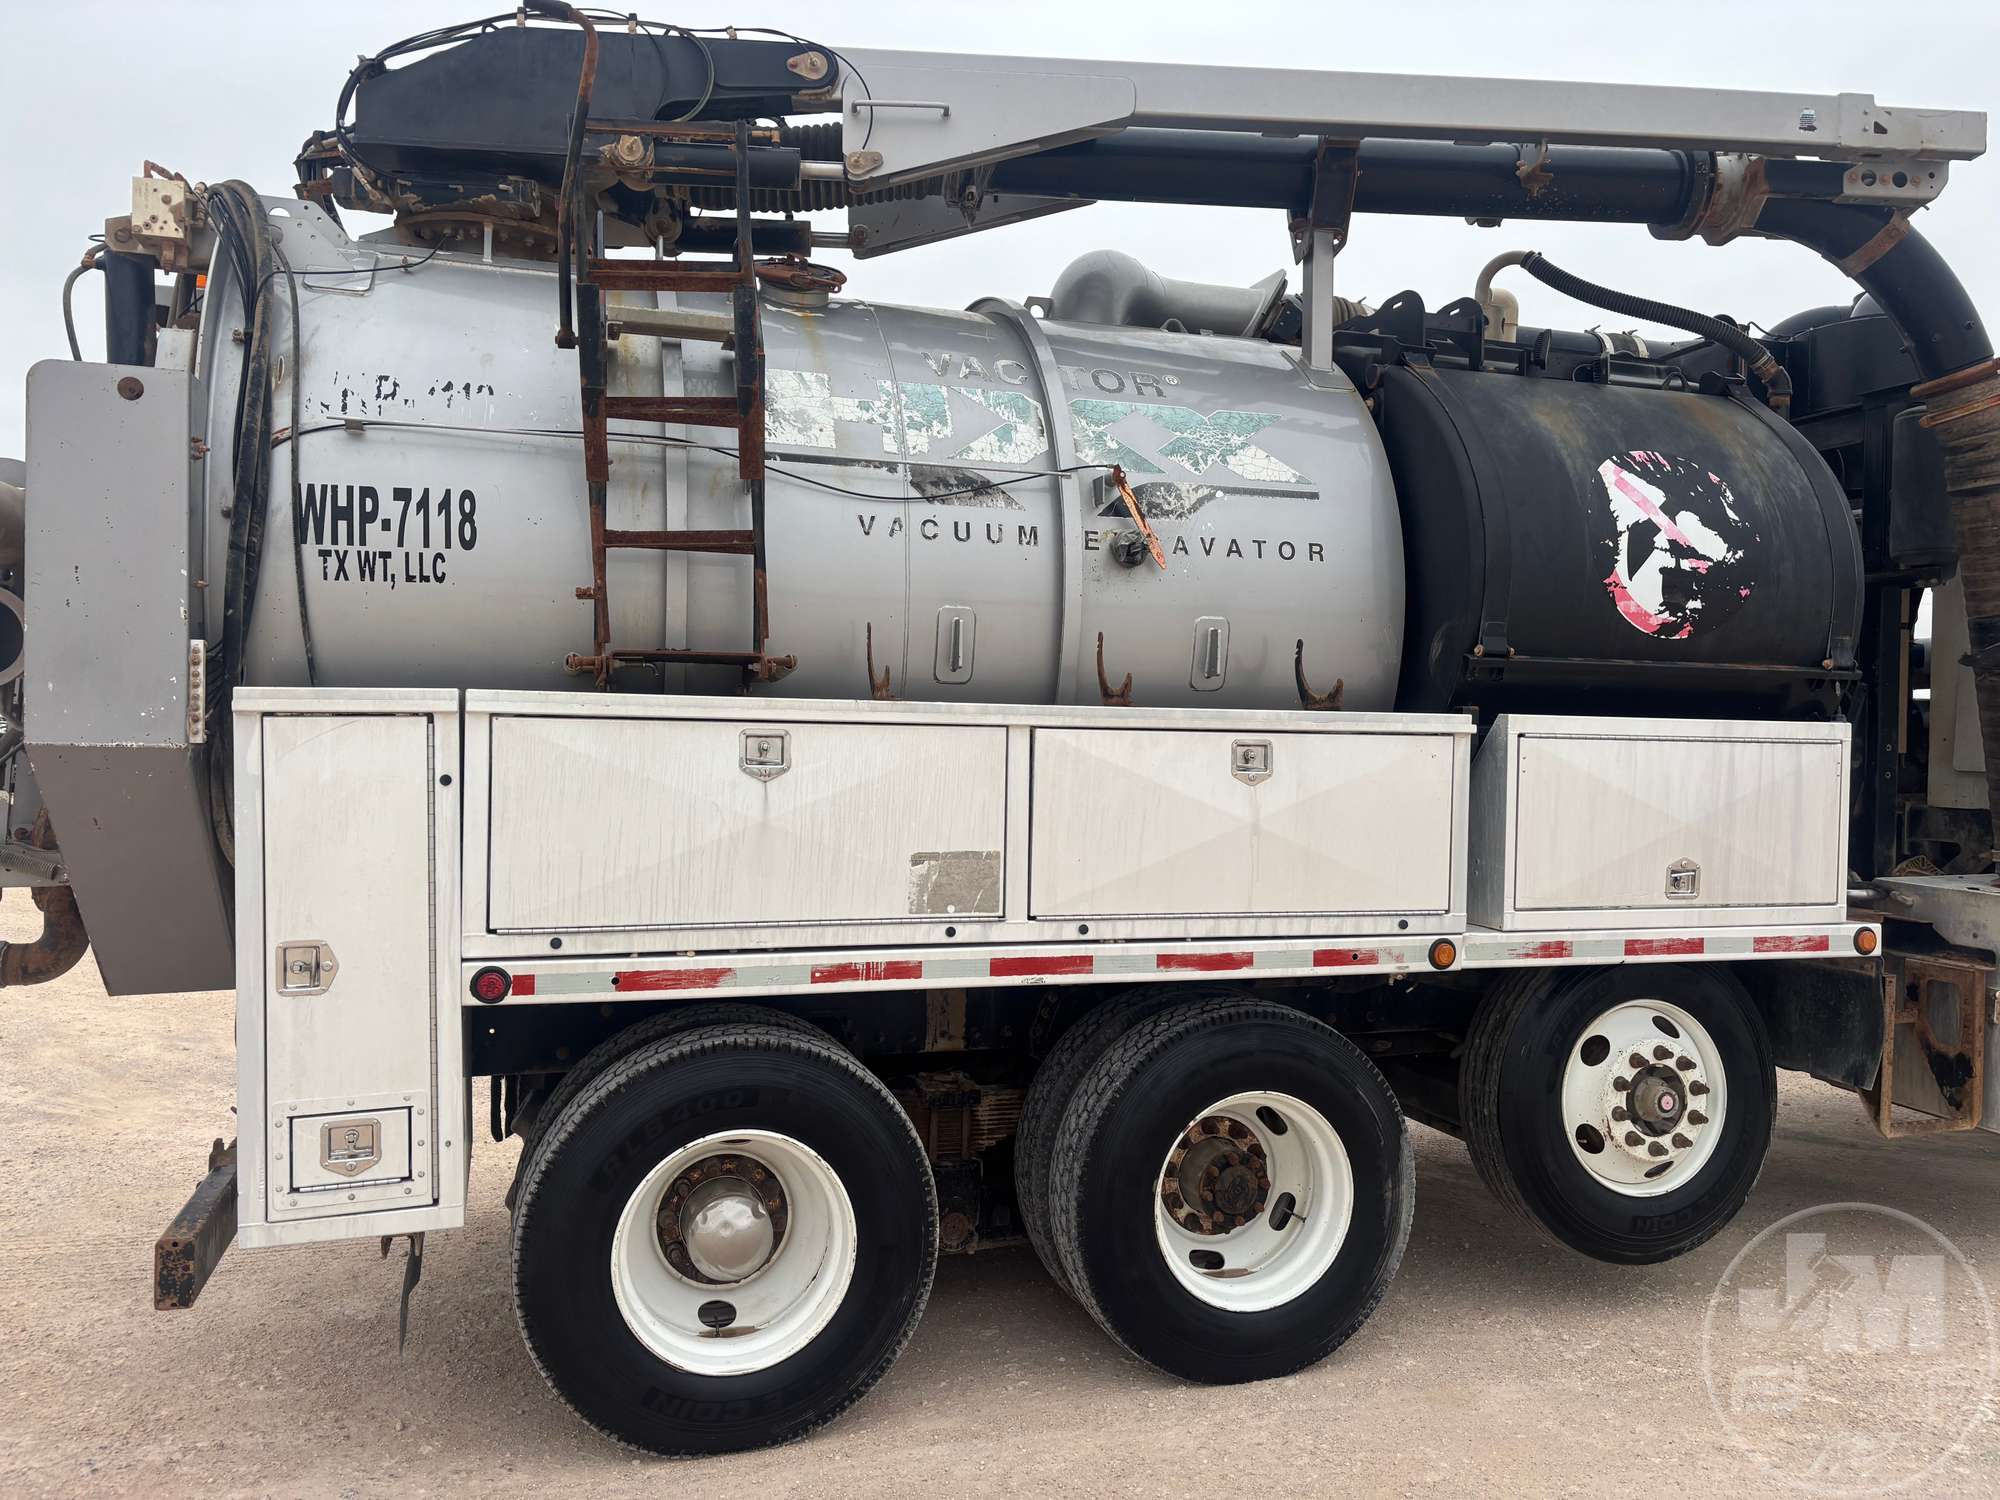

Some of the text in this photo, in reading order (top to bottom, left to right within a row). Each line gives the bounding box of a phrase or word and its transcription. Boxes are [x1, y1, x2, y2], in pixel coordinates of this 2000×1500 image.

[299, 483, 477, 550] WHP-7118
[857, 514, 1325, 562] VACUUM EAVATOR
[318, 549, 447, 590] TX WT, LLC
